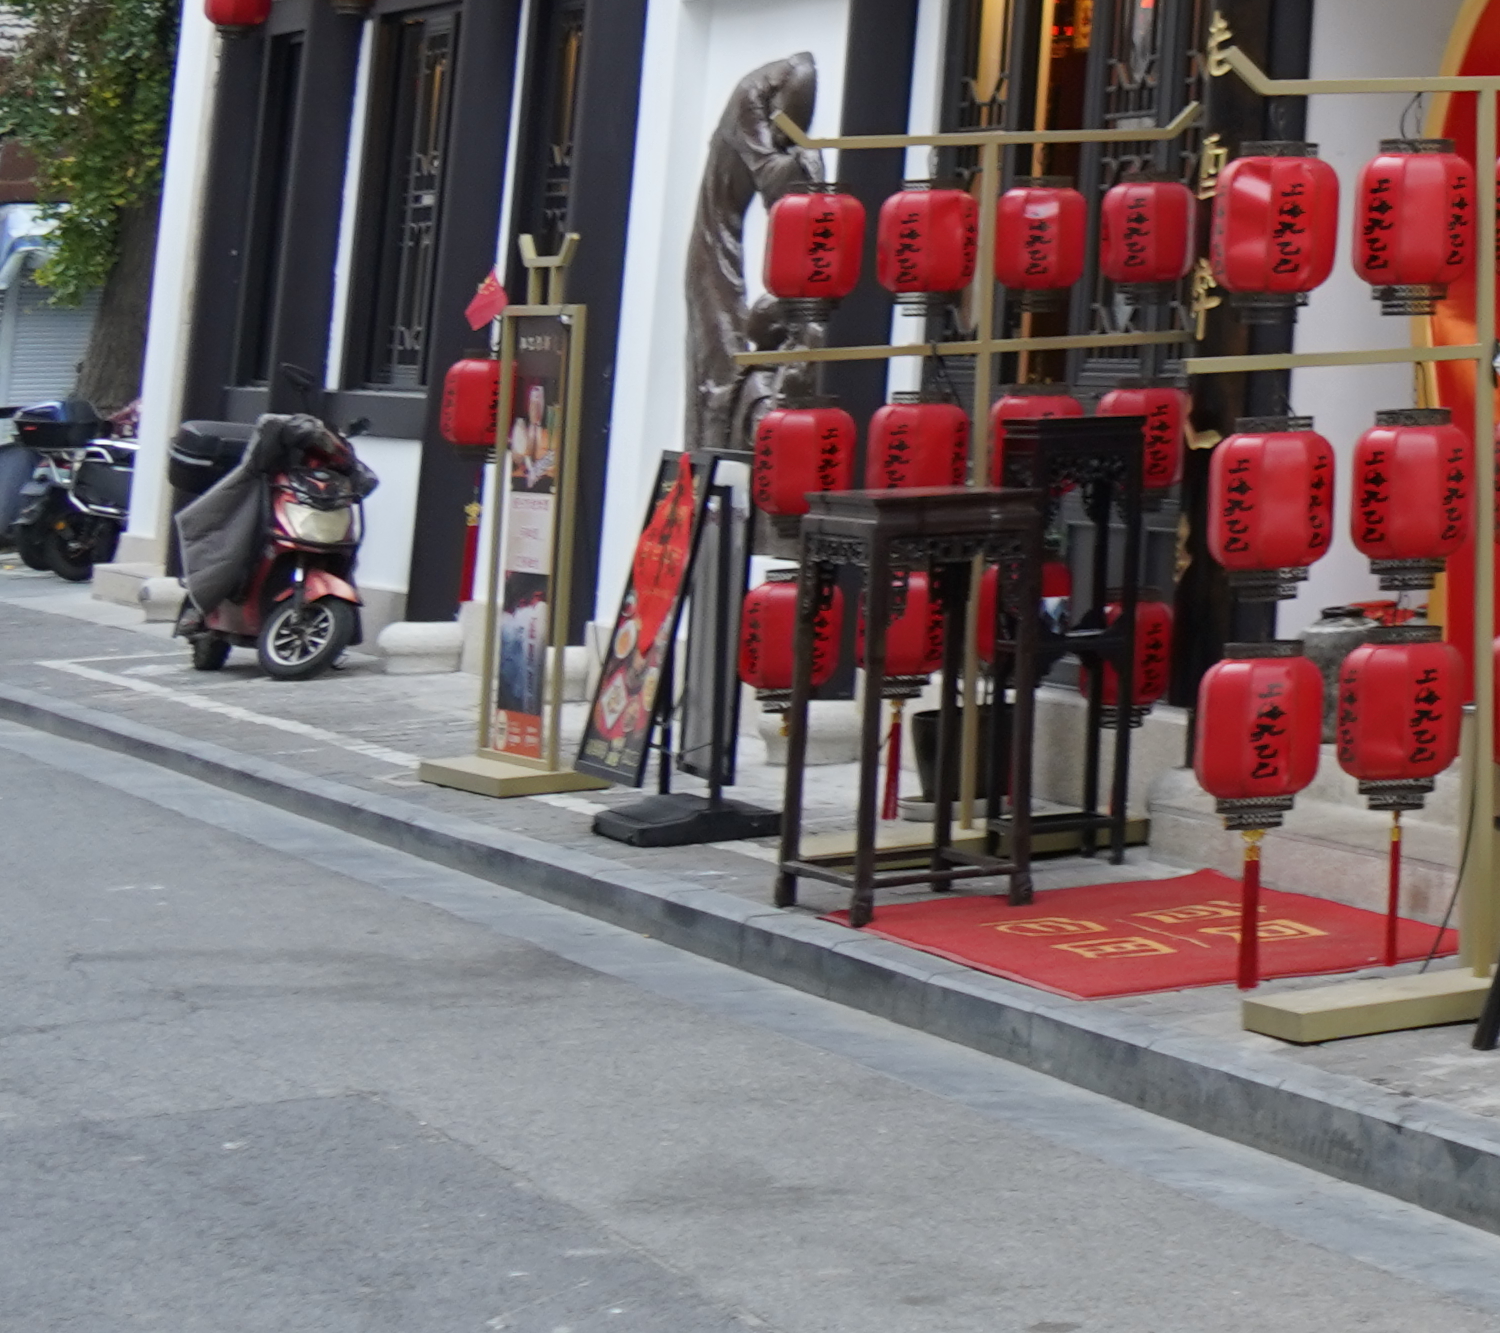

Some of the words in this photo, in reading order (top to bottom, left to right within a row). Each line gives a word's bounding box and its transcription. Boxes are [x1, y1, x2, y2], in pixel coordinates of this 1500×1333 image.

[1272, 183, 1304, 275] 上海孔乙己
[1363, 177, 1392, 271] 上海孔乙己
[1224, 457, 1252, 554] 上海孔乙己
[1361, 450, 1389, 544] 上海孔乙己
[1250, 681, 1285, 779] 上海孔乙己
[1408, 667, 1441, 764] 上海孔乙己
